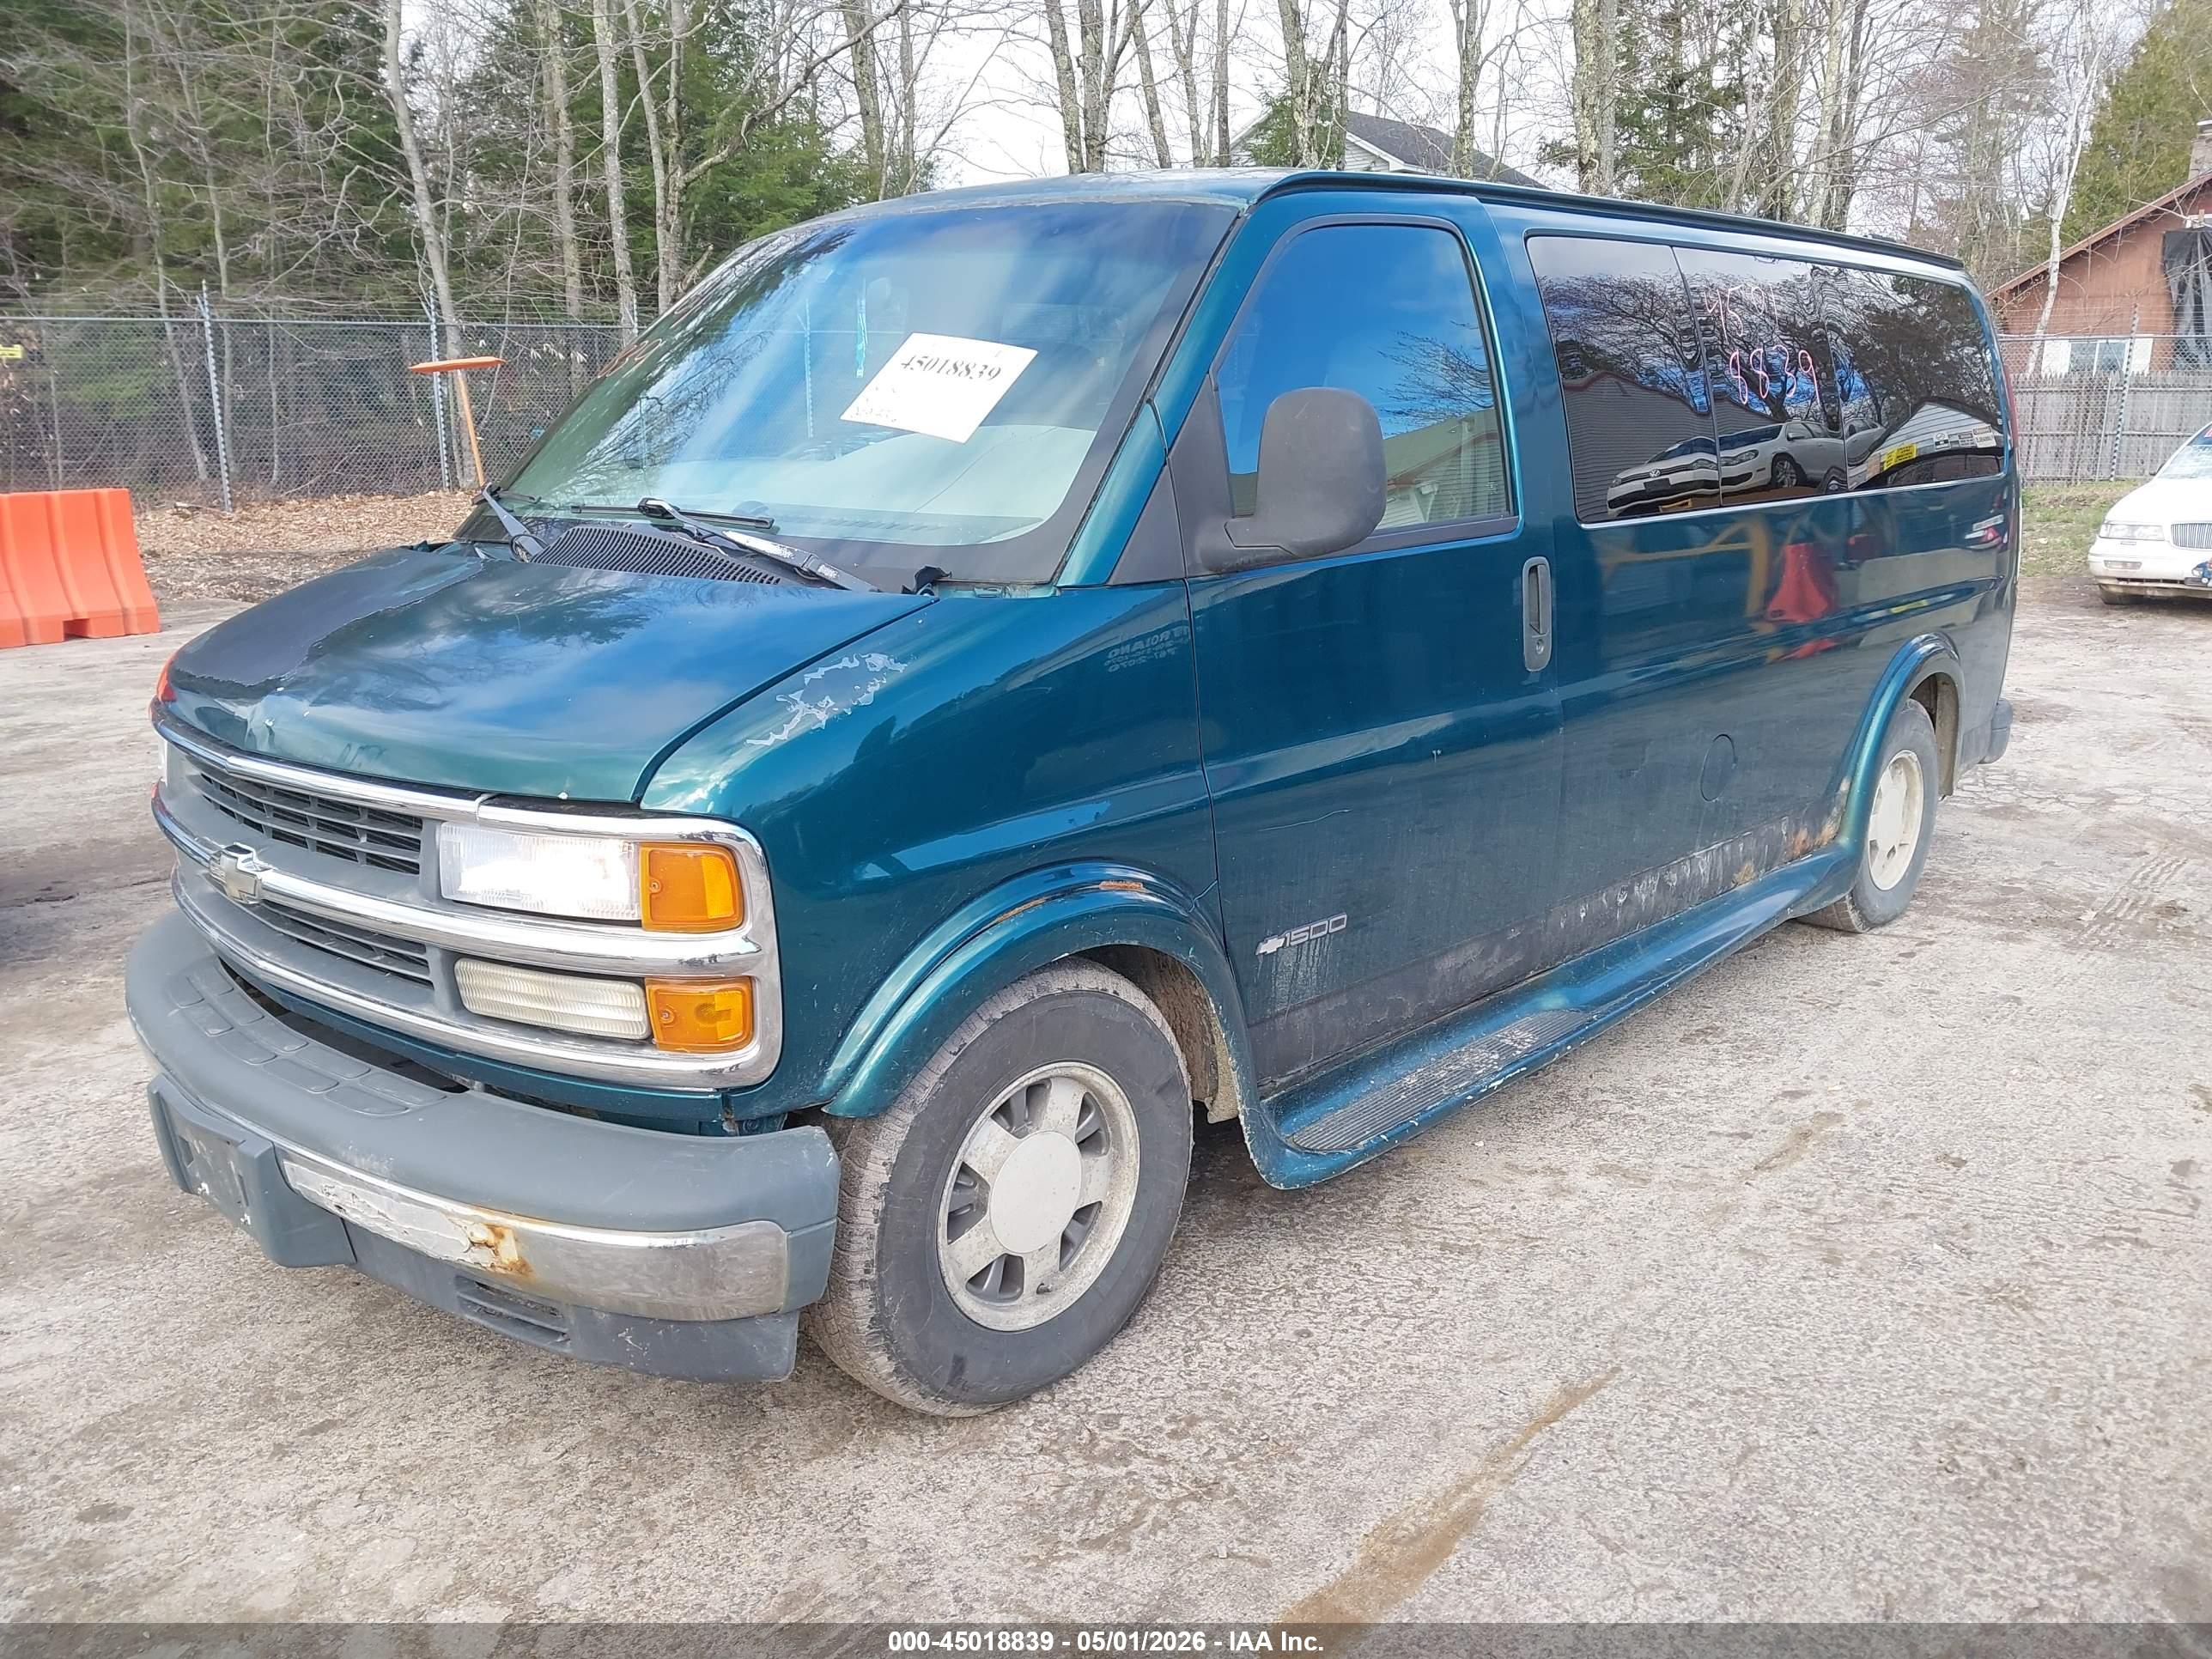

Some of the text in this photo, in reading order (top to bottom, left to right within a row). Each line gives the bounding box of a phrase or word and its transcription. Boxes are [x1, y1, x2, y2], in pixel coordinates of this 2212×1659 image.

[901, 354, 1002, 380] 45018839
[1729, 344, 1821, 407] 8839
[1285, 912, 1347, 947] 1500
